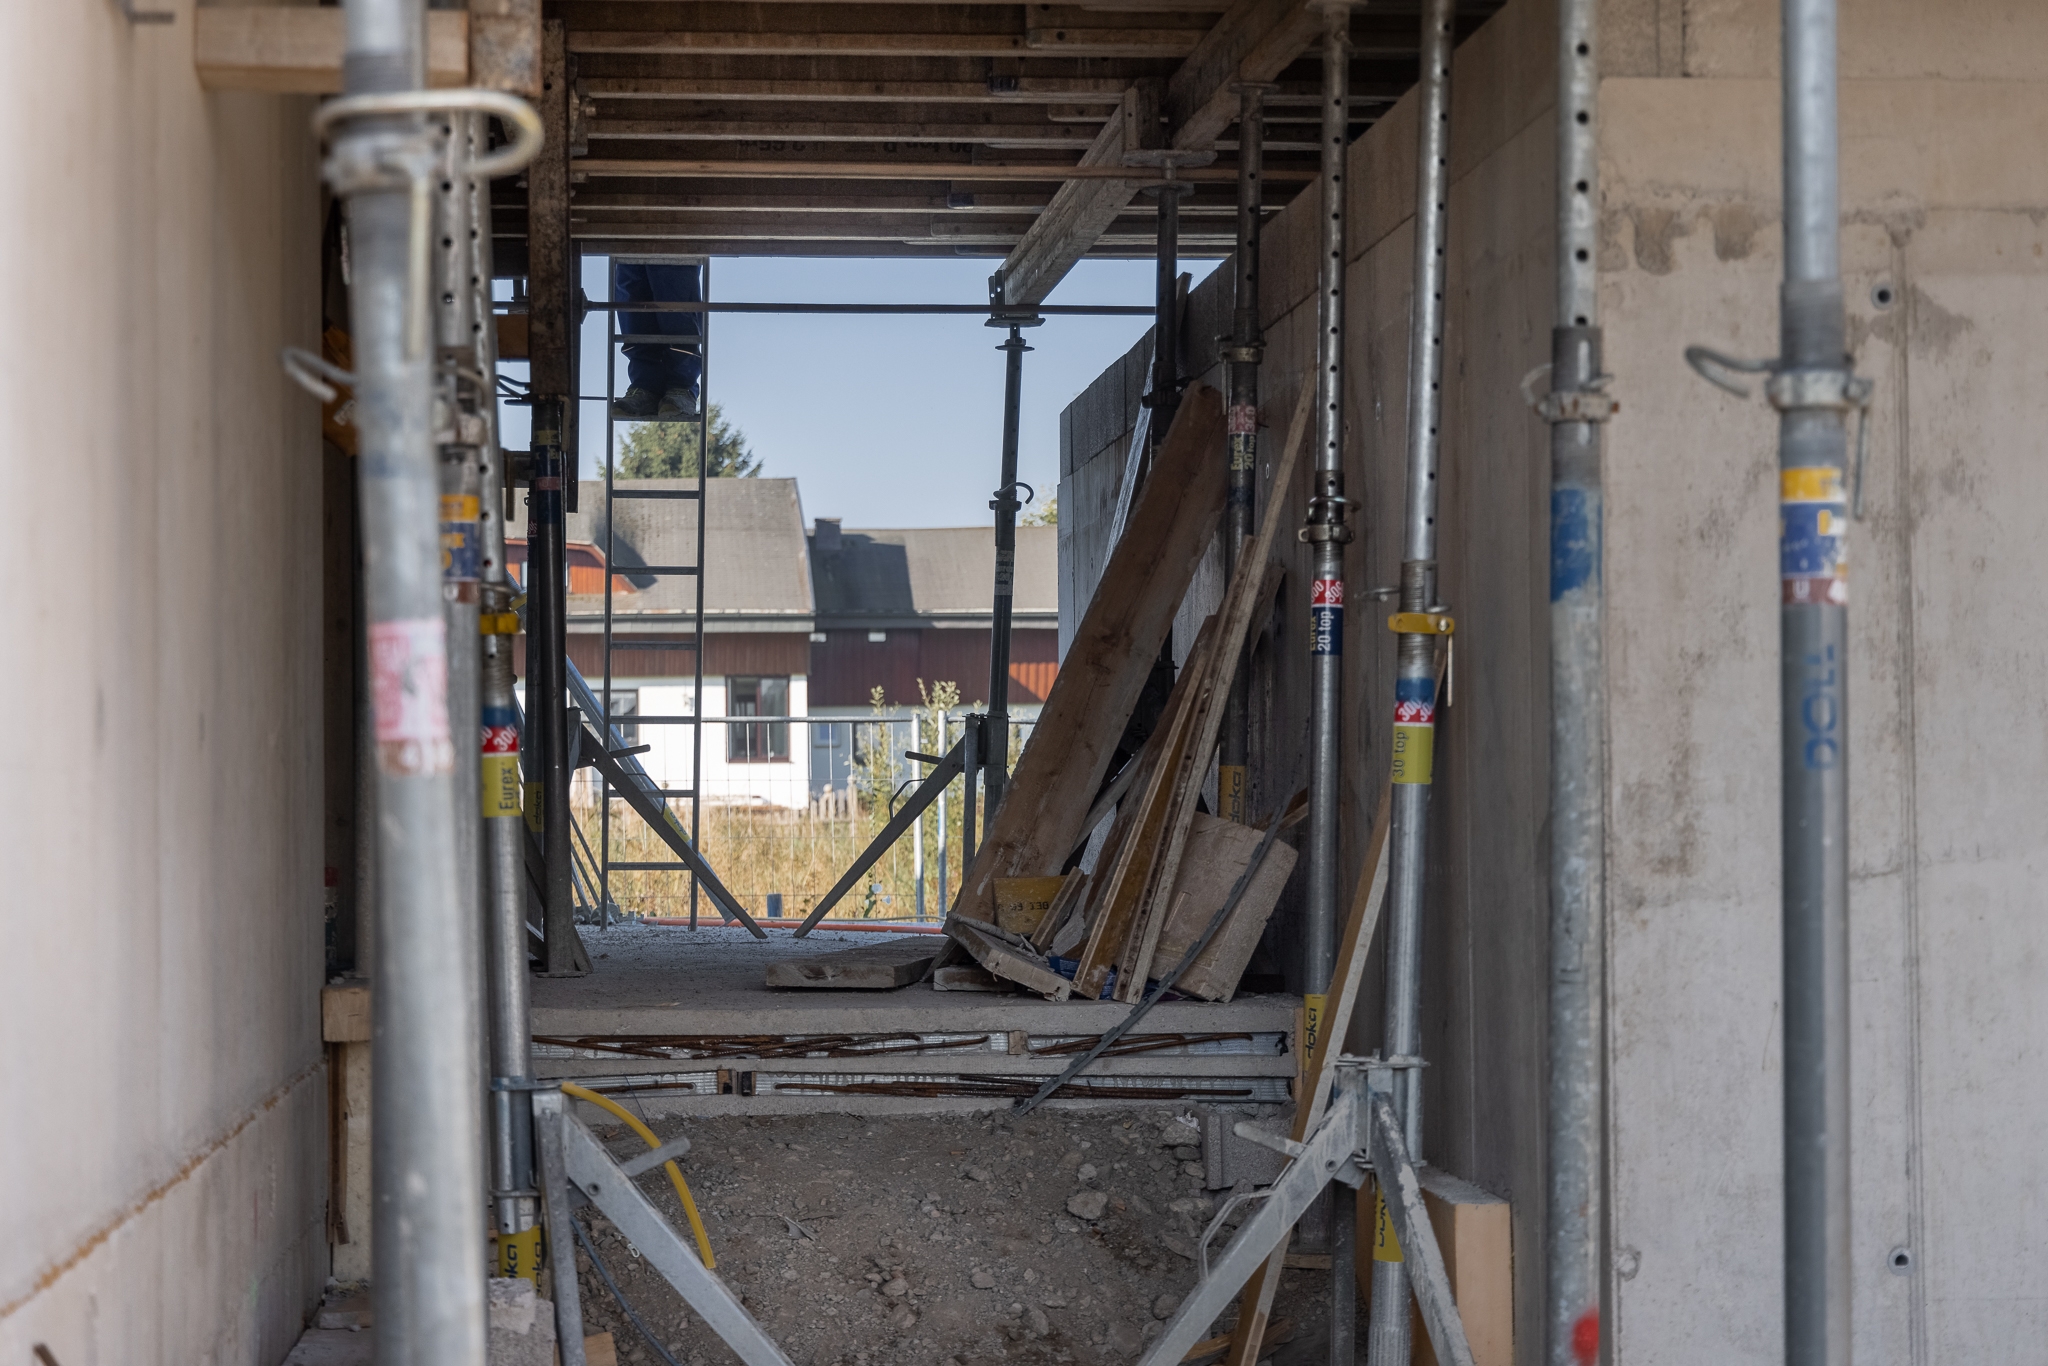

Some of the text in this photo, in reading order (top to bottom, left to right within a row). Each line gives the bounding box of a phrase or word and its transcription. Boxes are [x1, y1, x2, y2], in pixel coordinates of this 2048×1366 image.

[1230, 436, 1243, 471] Eurex
[1243, 435, 1256, 471] 20 top
[1317, 610, 1335, 652] 20 top
[1392, 731, 1409, 777] 30 top
[499, 767, 515, 810] Eurex
[533, 790, 542, 825] doka
